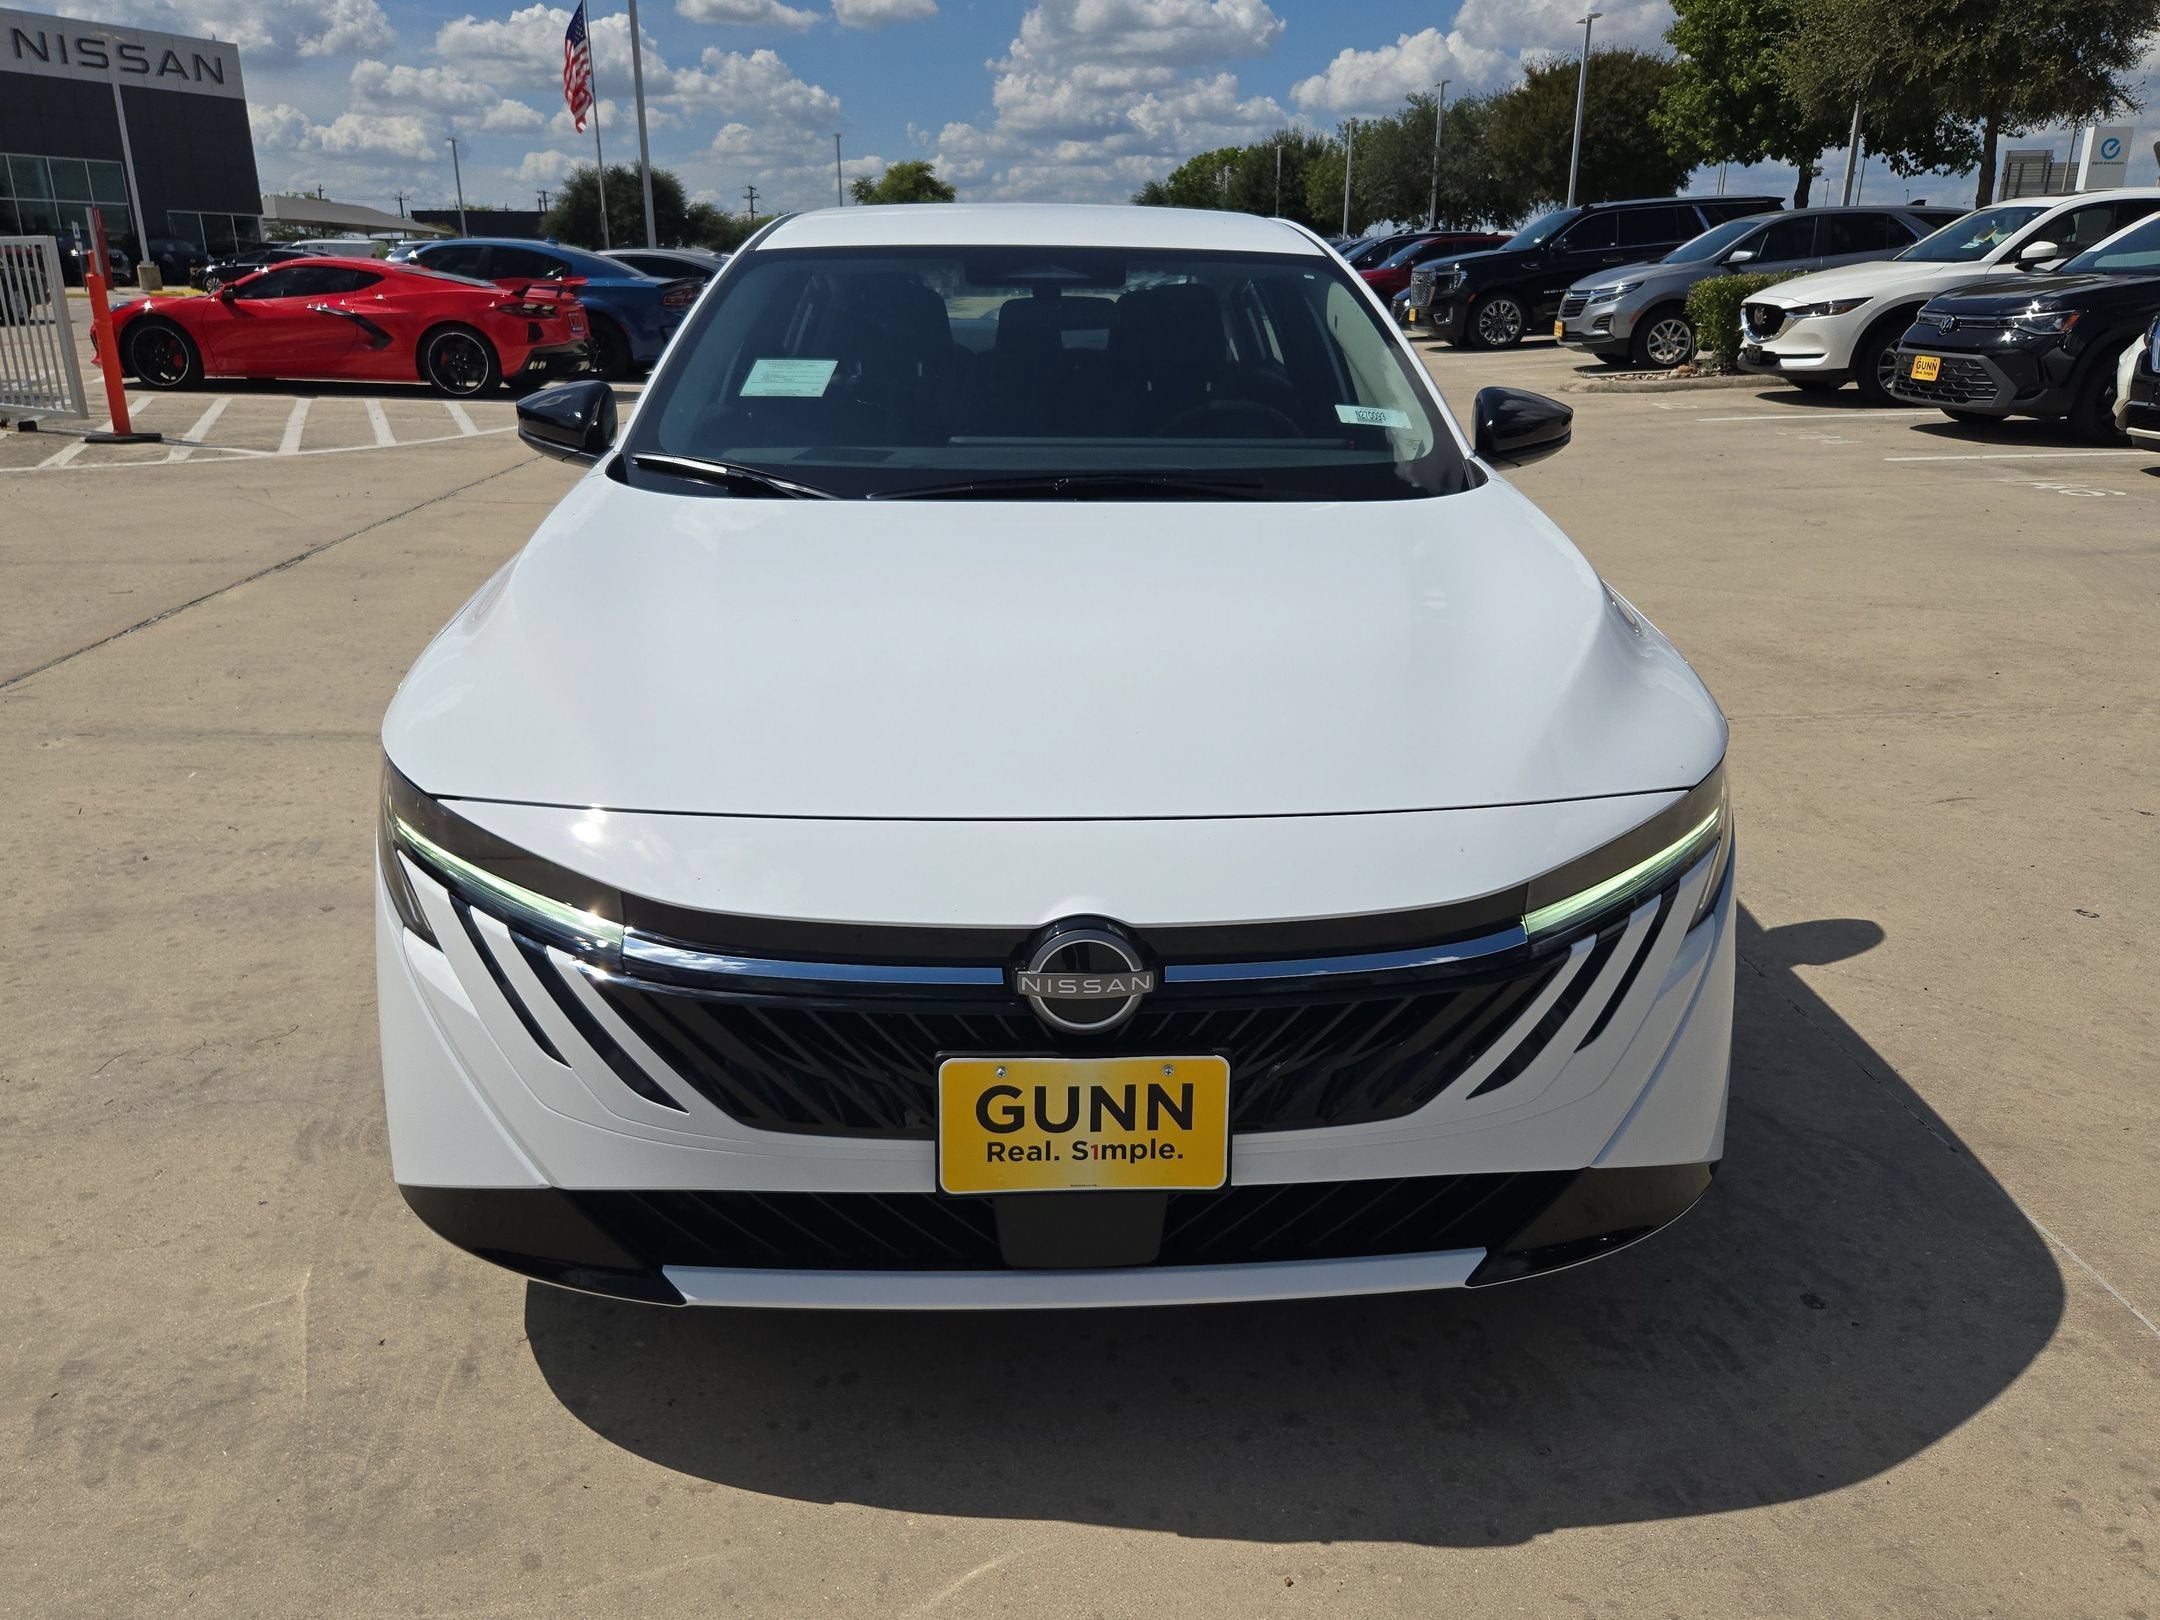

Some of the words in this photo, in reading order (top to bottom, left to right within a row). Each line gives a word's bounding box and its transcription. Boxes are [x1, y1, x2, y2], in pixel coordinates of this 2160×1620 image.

[10, 28, 225, 84] NISSAN
[1916, 360, 1937, 371] GUNN
[1021, 975, 1150, 994] NISSAN
[975, 1083, 1194, 1134] GUNN
[986, 1140, 1061, 1163] Real.
[1071, 1138, 1184, 1164] S1mple.
